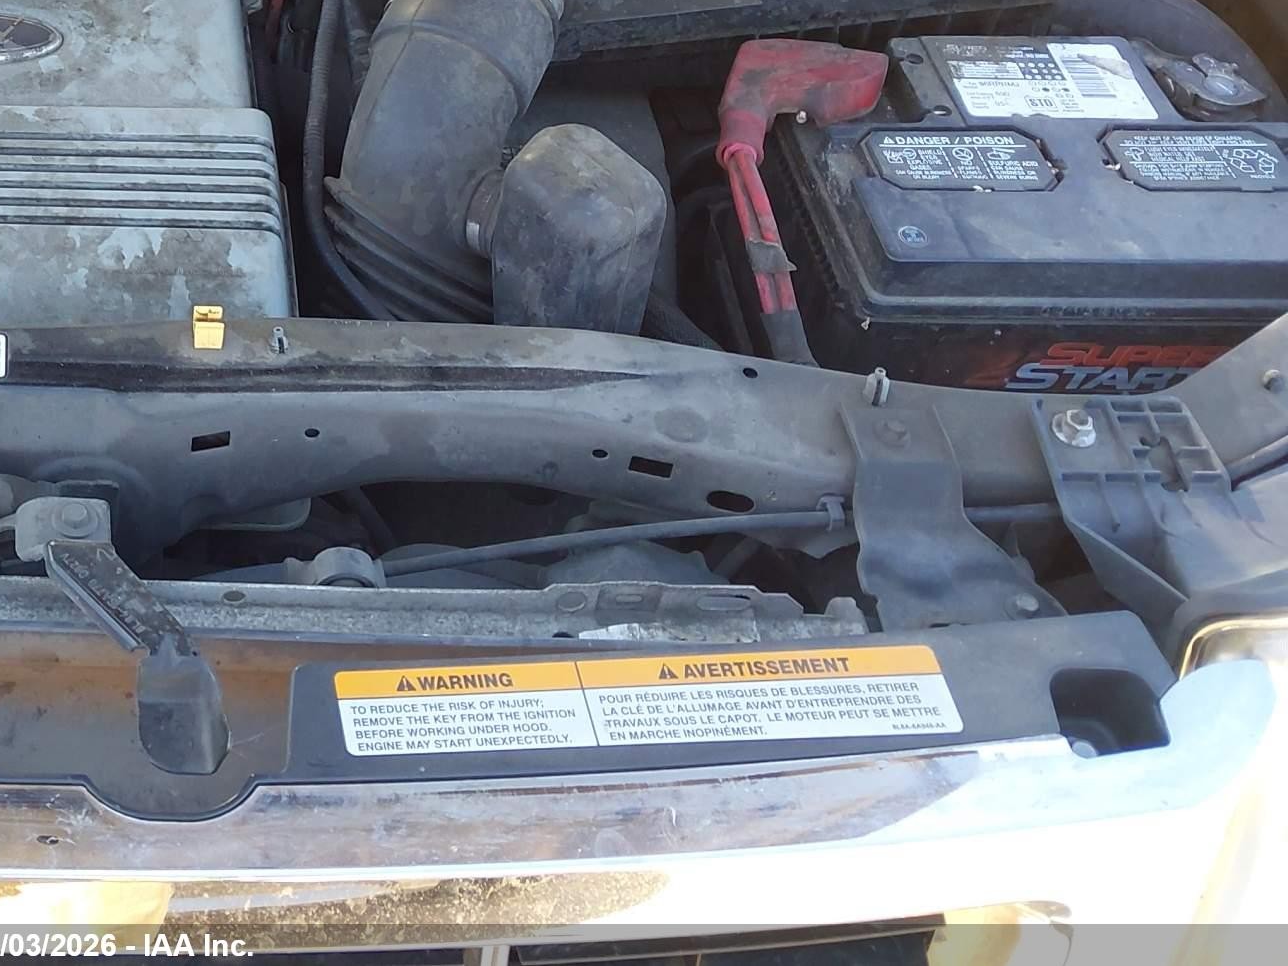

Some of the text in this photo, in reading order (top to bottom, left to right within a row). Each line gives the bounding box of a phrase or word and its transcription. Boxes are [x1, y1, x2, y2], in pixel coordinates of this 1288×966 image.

[895, 136, 950, 145] DANGER
[963, 136, 1014, 145] POISON
[1039, 342, 1233, 367] SUPER
[683, 657, 848, 678] AVERTISSEMENT
[416, 672, 513, 690] WARNING
[598, 694, 631, 704] POUR
[635, 690, 687, 702] RÉDUIRE
[691, 691, 712, 700] LES
[715, 689, 767, 699] RISQUES
[771, 688, 787, 697] DE
[868, 683, 918, 693] RETIRER
[350, 706, 366, 715] TO
[370, 704, 417, 714] REDUCE
[421, 703, 444, 712] THE
[448, 701, 475, 711] RISK
[481, 701, 495, 710] OF
[603, 695, 921, 716] LA CLÉ DE L'ALLUMAGE AVANT D'ENTREPRENDRE DES
[353, 709, 576, 726] REMOVE THE KEY FROM THE IGNITION
[606, 707, 942, 728] TRAVAUX SOUS LE CAPOT. LE MOTEUR PEUT SE METTRE
[355, 722, 551, 739] BEFORE WORKING UNDER HOOD.
[610, 731, 625, 741] EN
[629, 729, 680, 740] MARCHE
[358, 741, 402, 751] ENGINE
[406, 740, 430, 749] MAY
[433, 738, 472, 748] START
